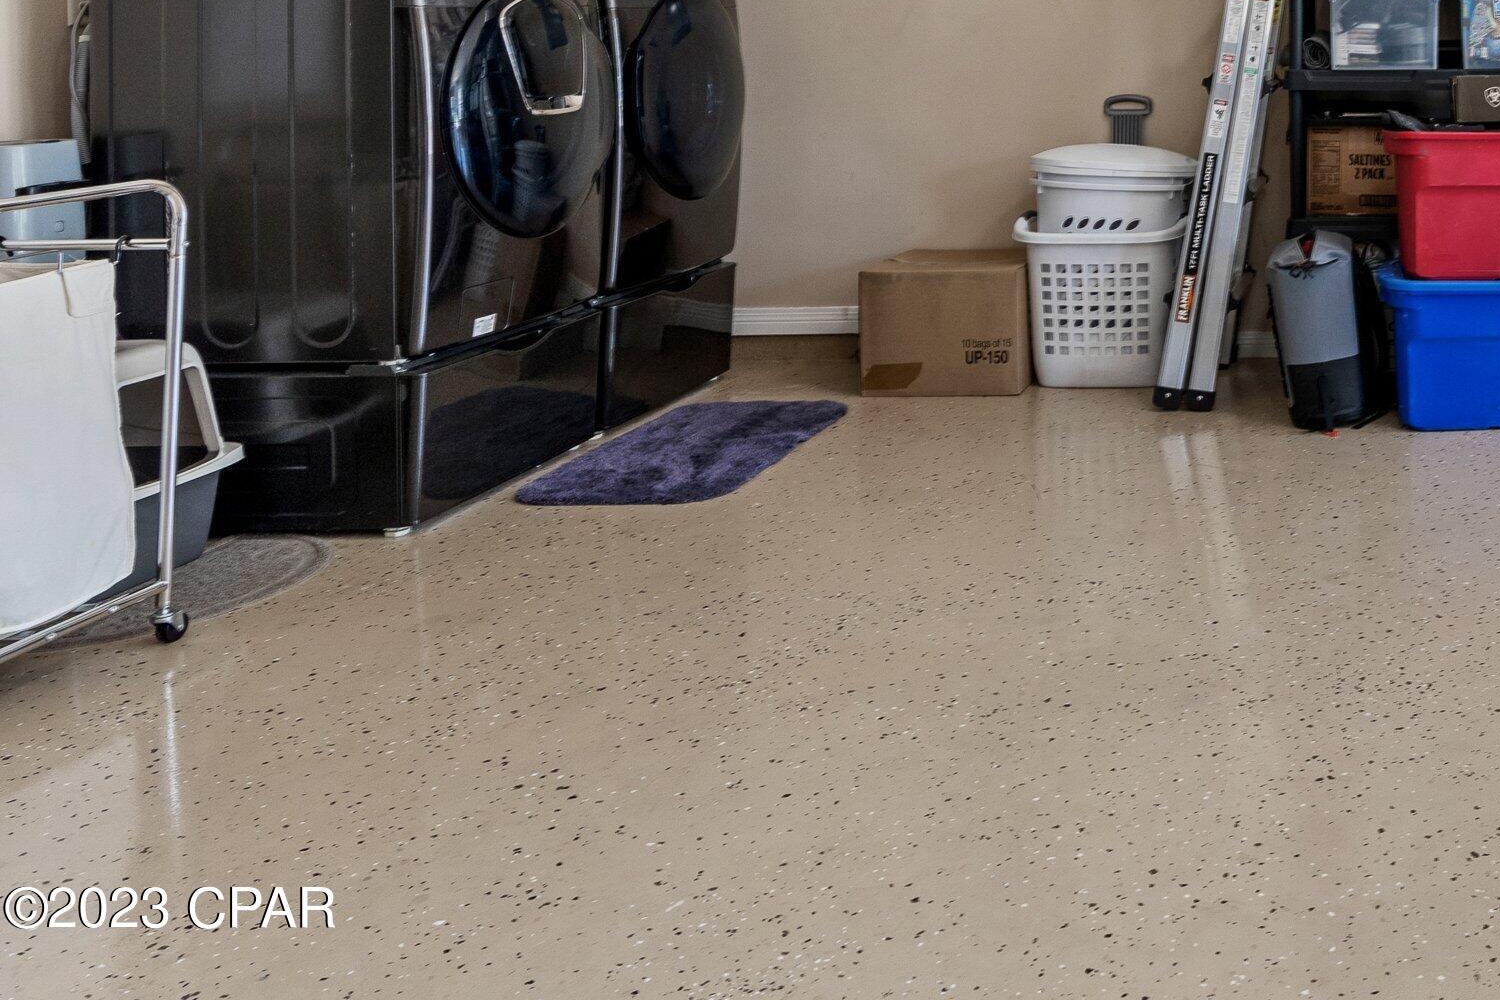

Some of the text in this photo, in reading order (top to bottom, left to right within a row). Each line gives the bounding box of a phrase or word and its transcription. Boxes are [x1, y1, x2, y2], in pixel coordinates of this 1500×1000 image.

[1348, 153, 1391, 167] SALTINES
[1203, 154, 1215, 192] LADDER
[1354, 168, 1385, 180] 2 PACK
[1177, 275, 1196, 322] FRANKLIN
[965, 350, 1008, 365] UP-150
